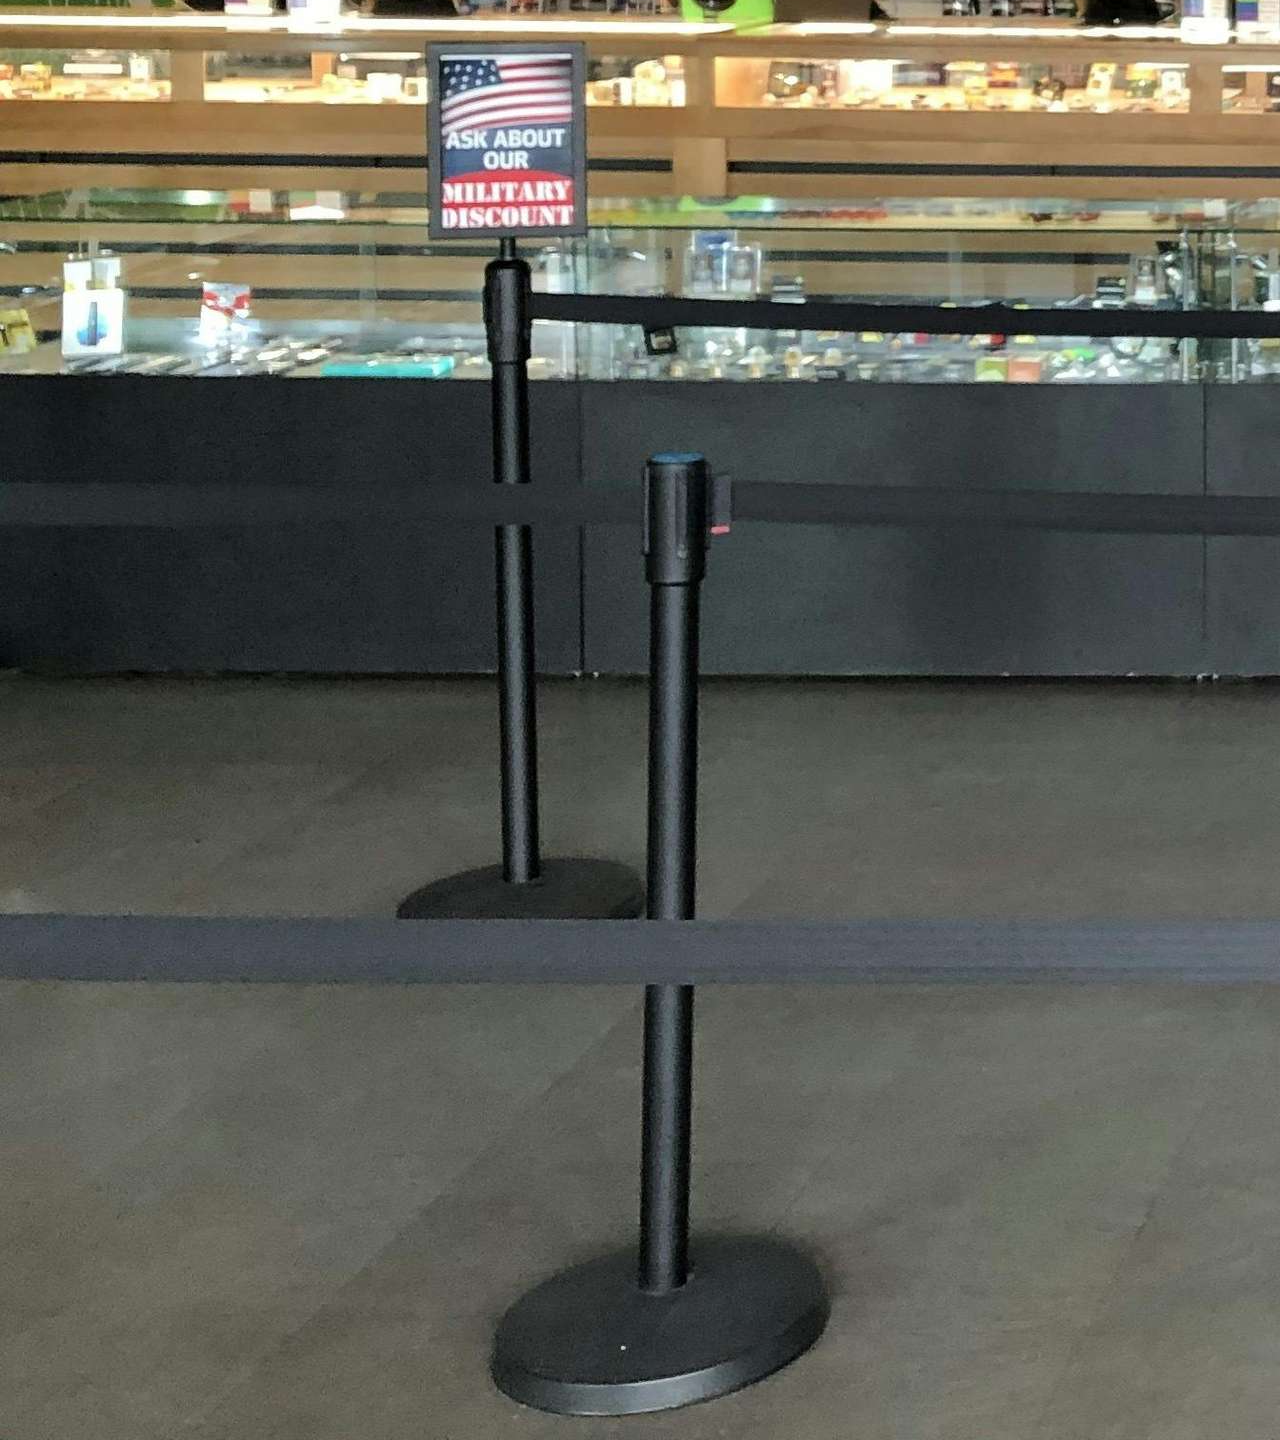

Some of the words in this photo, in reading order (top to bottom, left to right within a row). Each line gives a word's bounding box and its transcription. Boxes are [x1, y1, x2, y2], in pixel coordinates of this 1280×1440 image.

[446, 130, 488, 150] ASK
[493, 128, 566, 149] ABOUT
[483, 151, 529, 170] OUR
[442, 180, 570, 203] MILITARY
[441, 205, 574, 229] DISCOUNT
